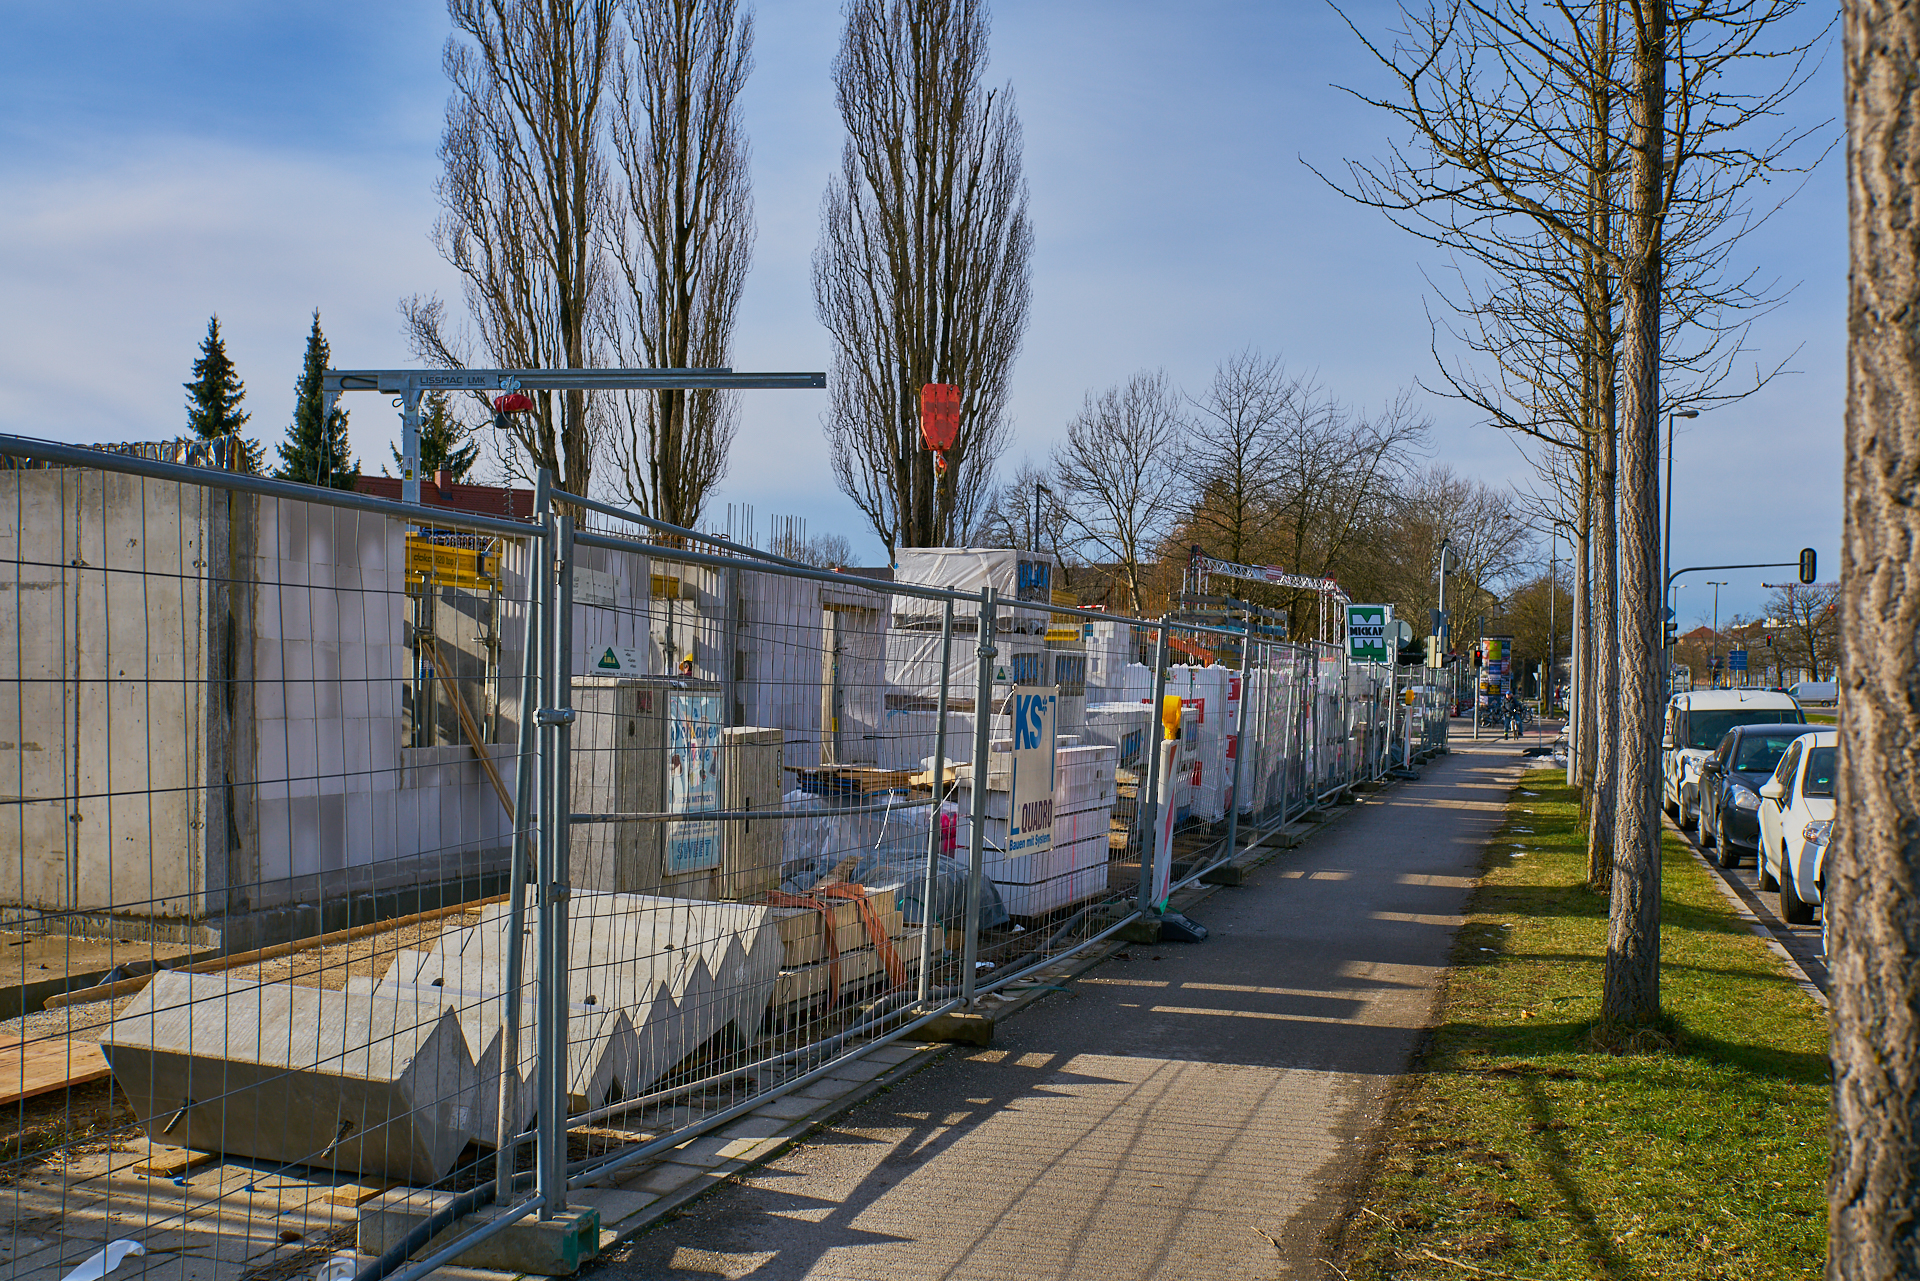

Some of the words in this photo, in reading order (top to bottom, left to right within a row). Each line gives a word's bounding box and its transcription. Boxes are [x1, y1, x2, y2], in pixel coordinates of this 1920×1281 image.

[420, 376, 462, 384] LISSMAC
[467, 376, 486, 384] LMK
[1021, 798, 1053, 834] QUADRO
[677, 839, 711, 860] SWEET
[1009, 839, 1026, 852] Bauen
[1026, 835, 1035, 847] mit
